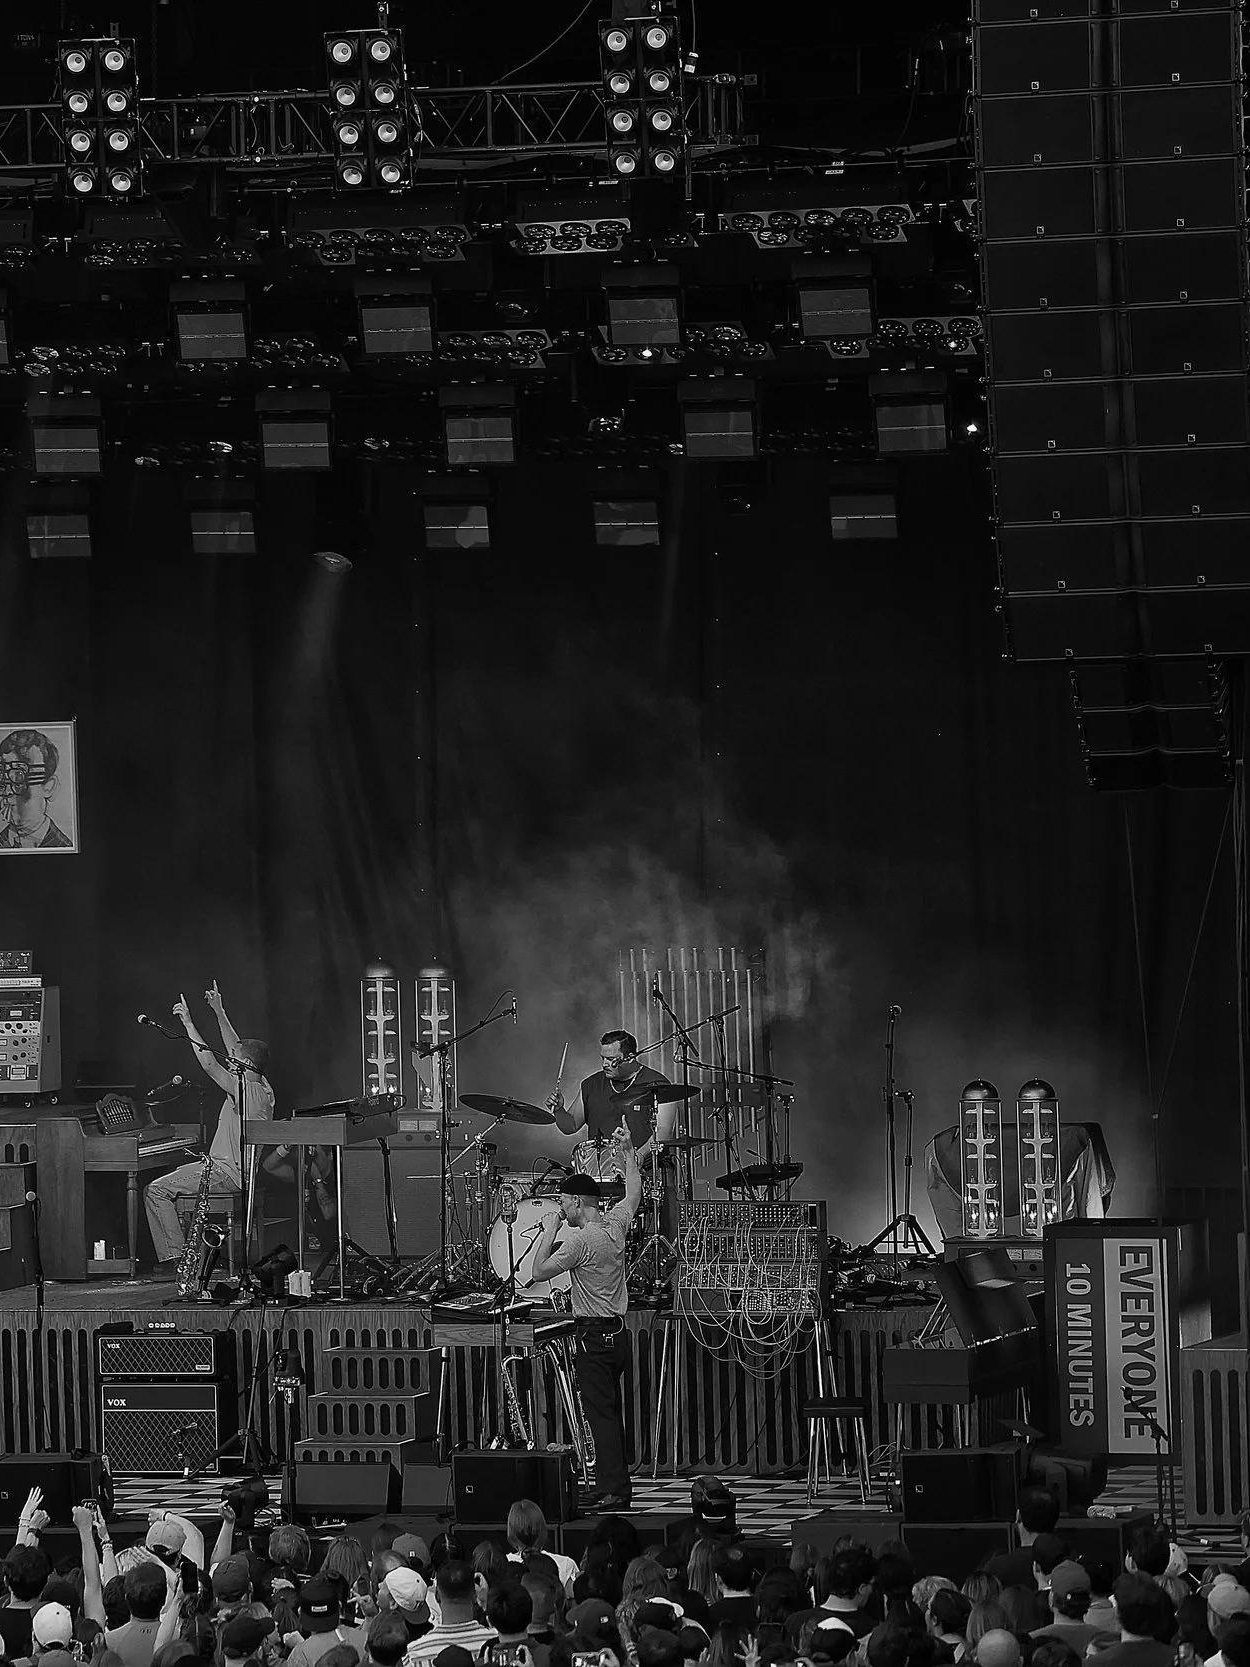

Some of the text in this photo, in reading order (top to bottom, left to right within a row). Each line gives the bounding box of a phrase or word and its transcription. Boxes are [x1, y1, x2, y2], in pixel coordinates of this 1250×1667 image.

[107, 1399, 127, 1407] VOX
[1066, 1263, 1095, 1427] 10 MINUTES
[1119, 1245, 1157, 1439] EVERYONE
